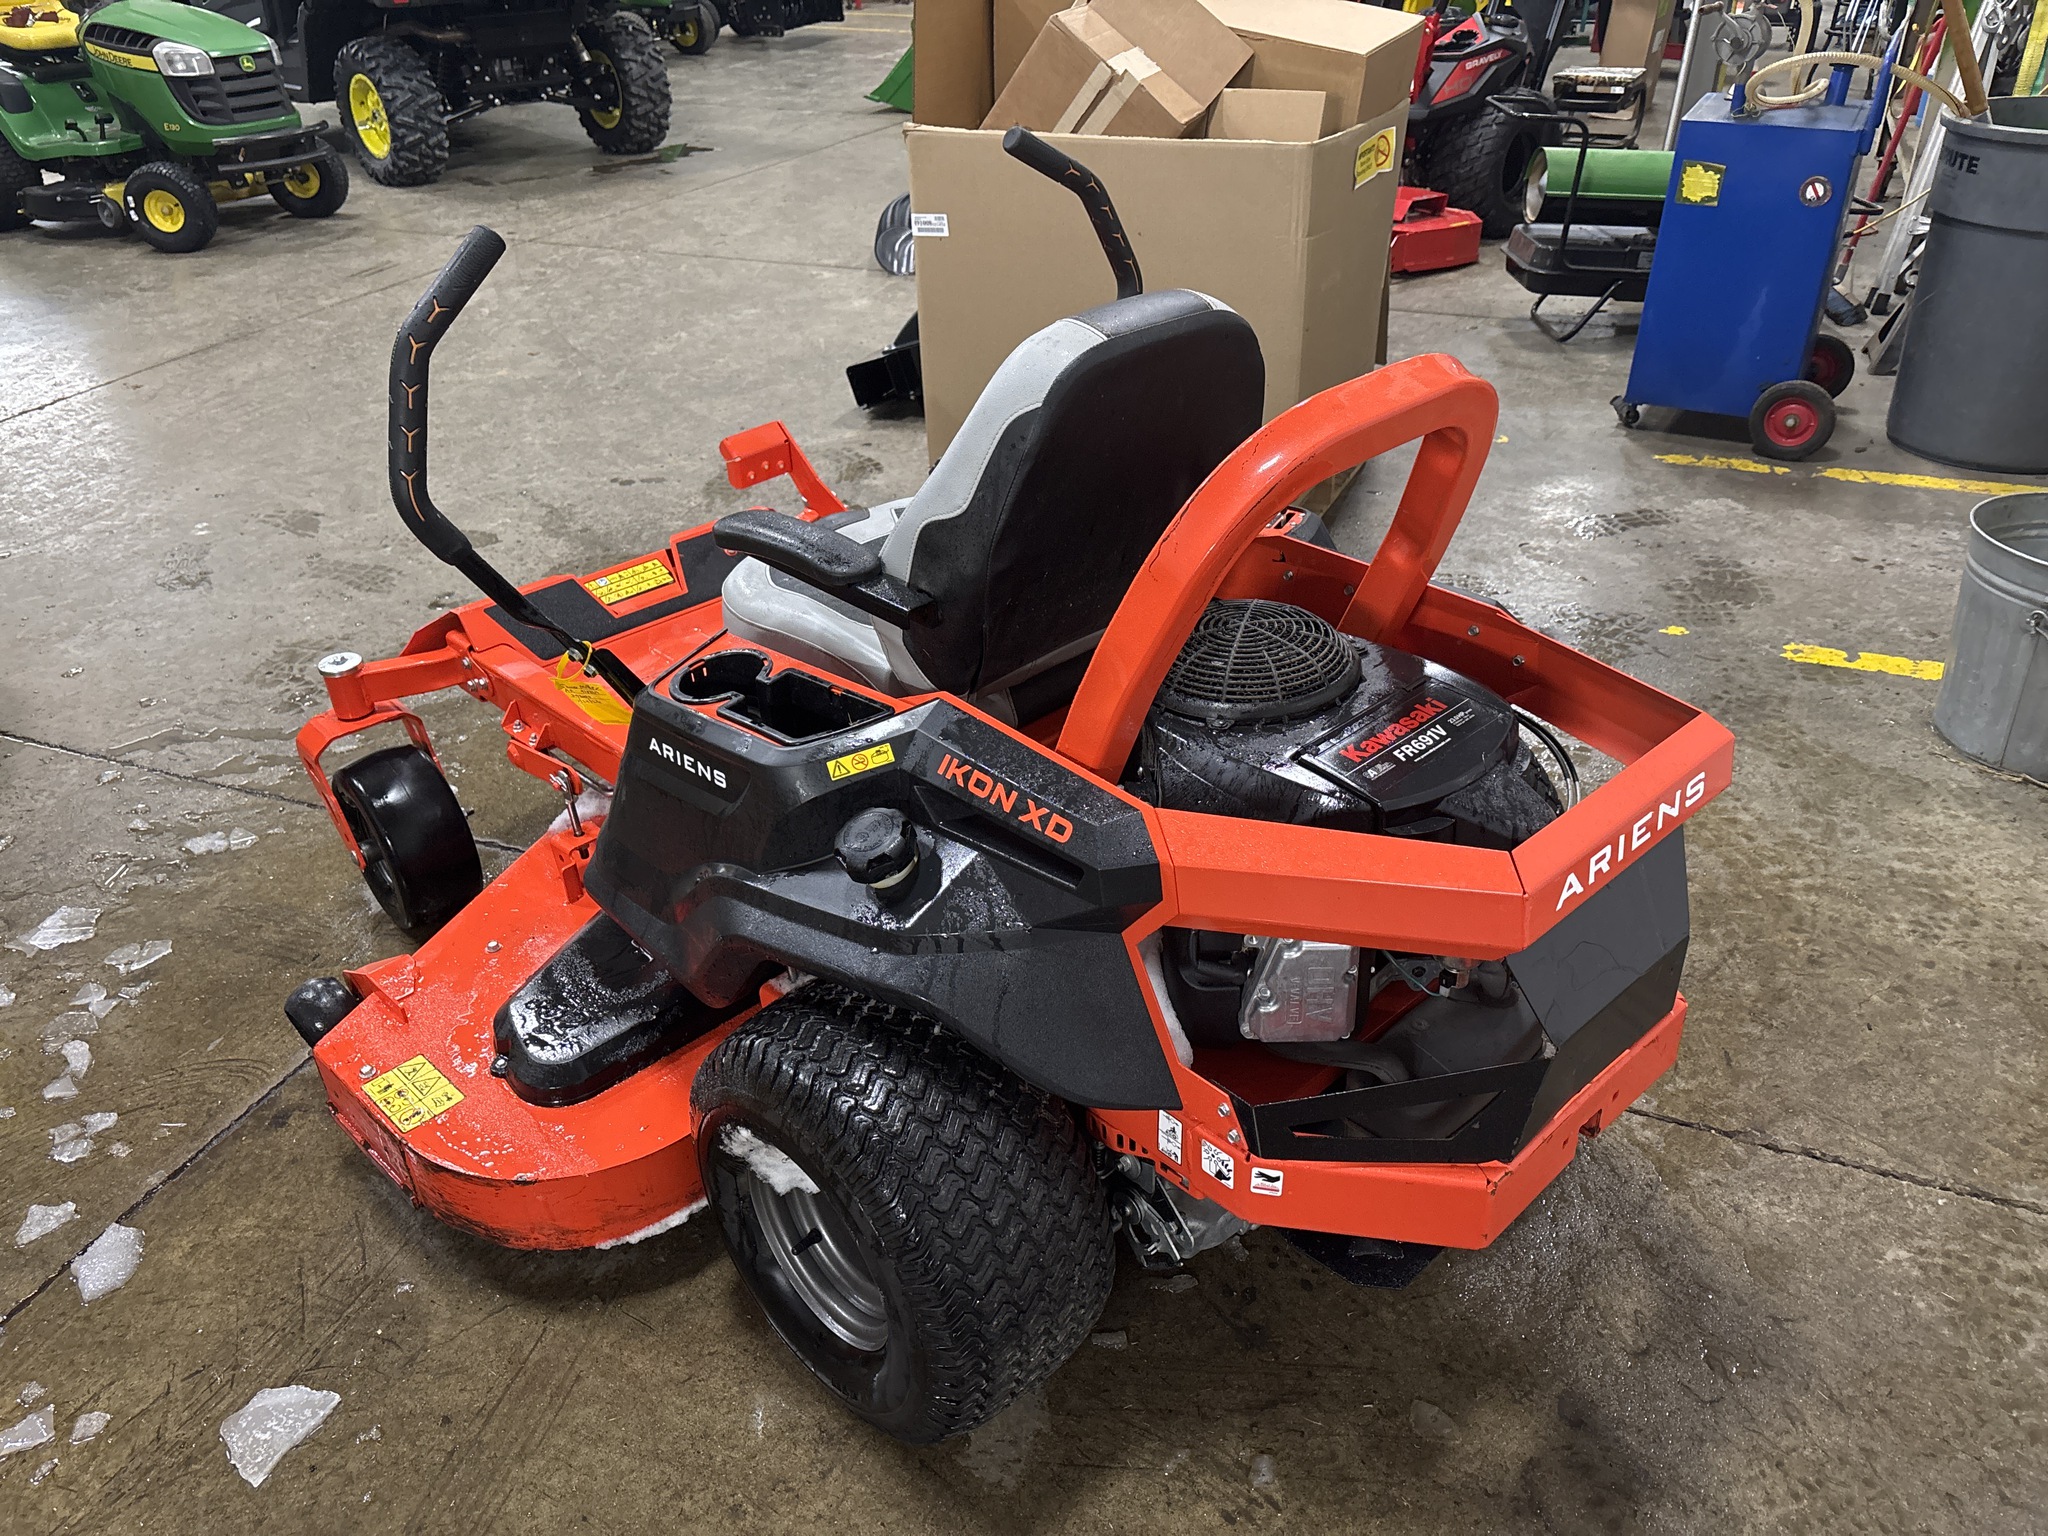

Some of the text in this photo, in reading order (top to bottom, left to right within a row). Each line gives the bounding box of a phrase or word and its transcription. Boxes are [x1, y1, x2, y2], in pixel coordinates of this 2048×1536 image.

[1465, 50, 1503, 70] GRAVELY
[1339, 697, 1448, 763] Kawasaki
[1392, 724, 1448, 762] FR691V
[649, 737, 727, 789] ARIENS
[937, 753, 1074, 844] IKON XD
[1555, 771, 1706, 912] ARIENS
